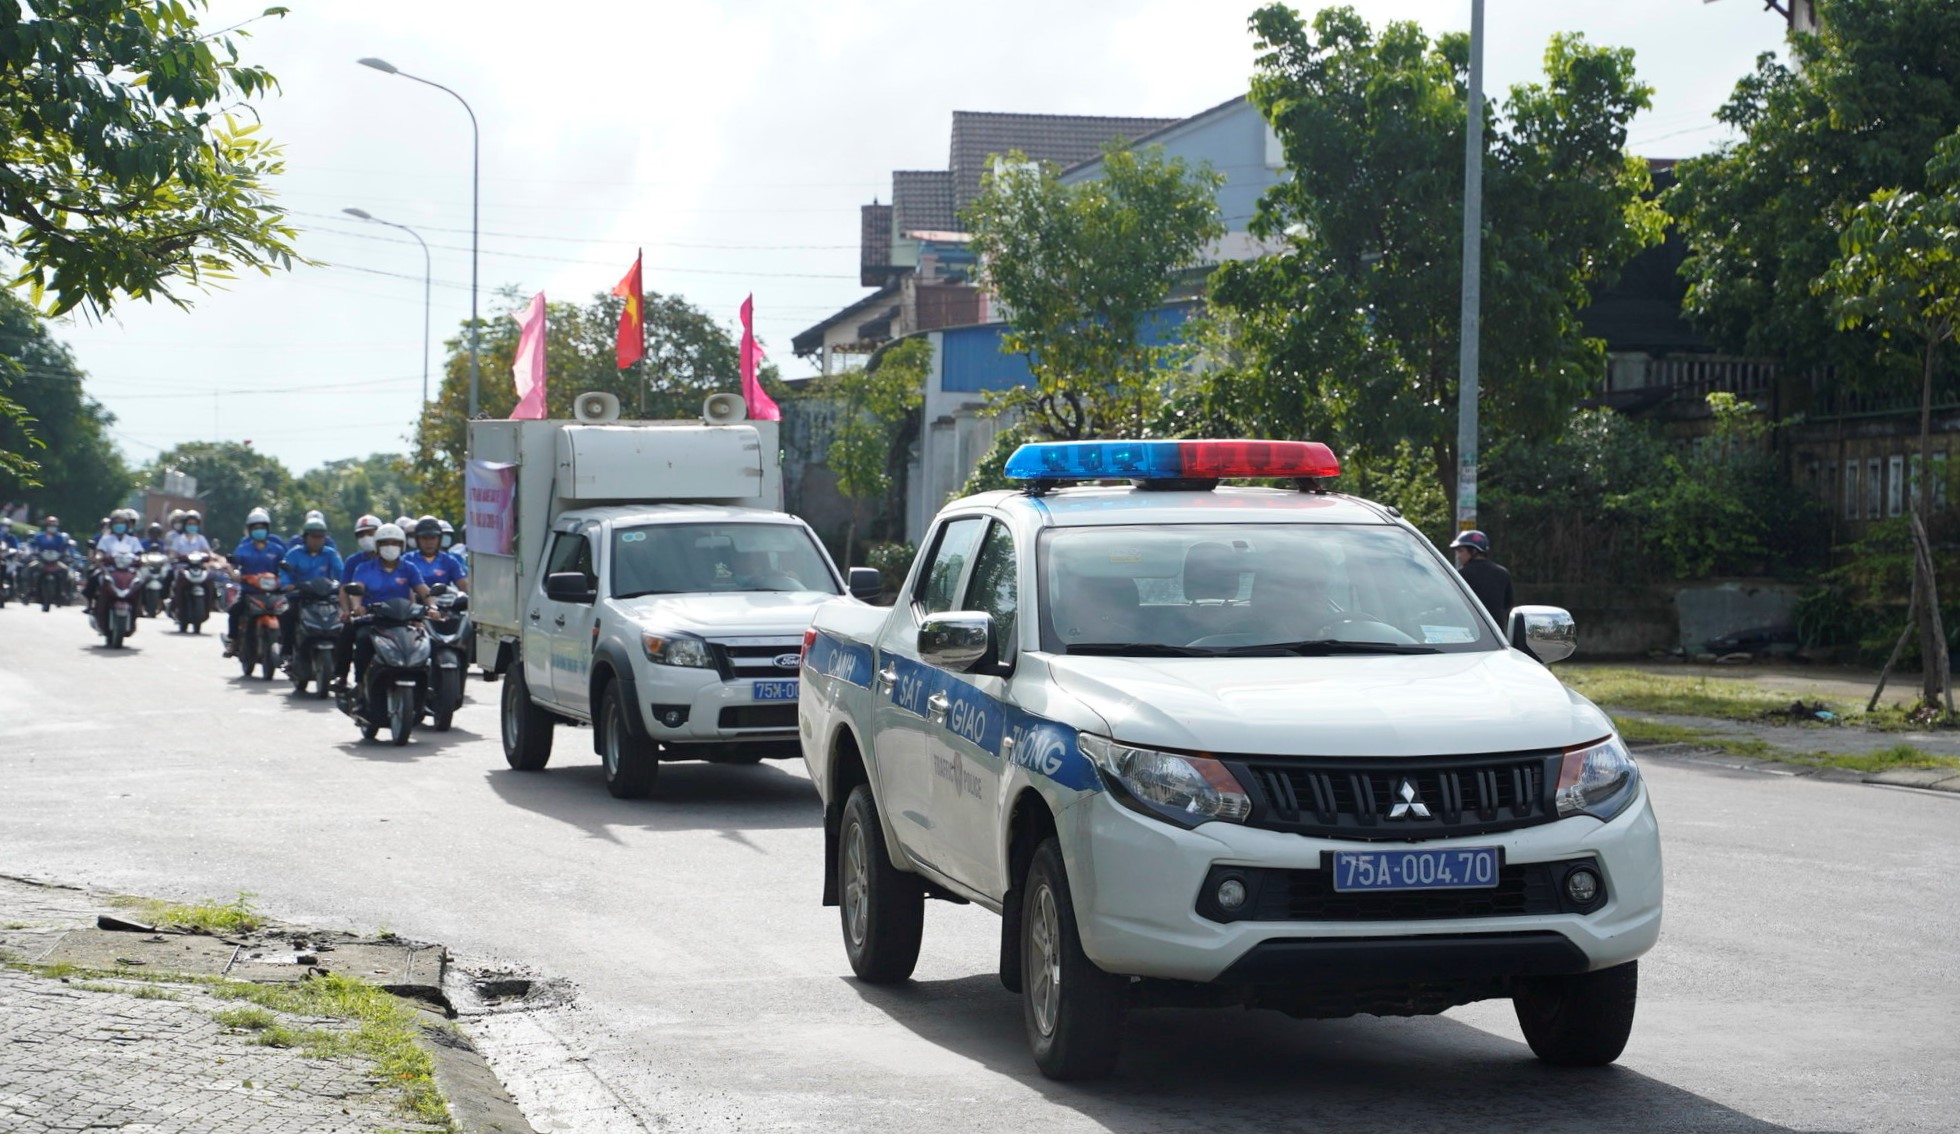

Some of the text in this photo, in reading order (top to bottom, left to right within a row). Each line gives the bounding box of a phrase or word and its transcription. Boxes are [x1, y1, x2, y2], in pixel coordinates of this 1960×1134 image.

[899, 670, 923, 711] SÁT
[952, 699, 986, 744] GIAO
[1011, 723, 1066, 775] THÔNG
[963, 769, 982, 800] POLICE
[1341, 852, 1492, 887] 75A-004.70
